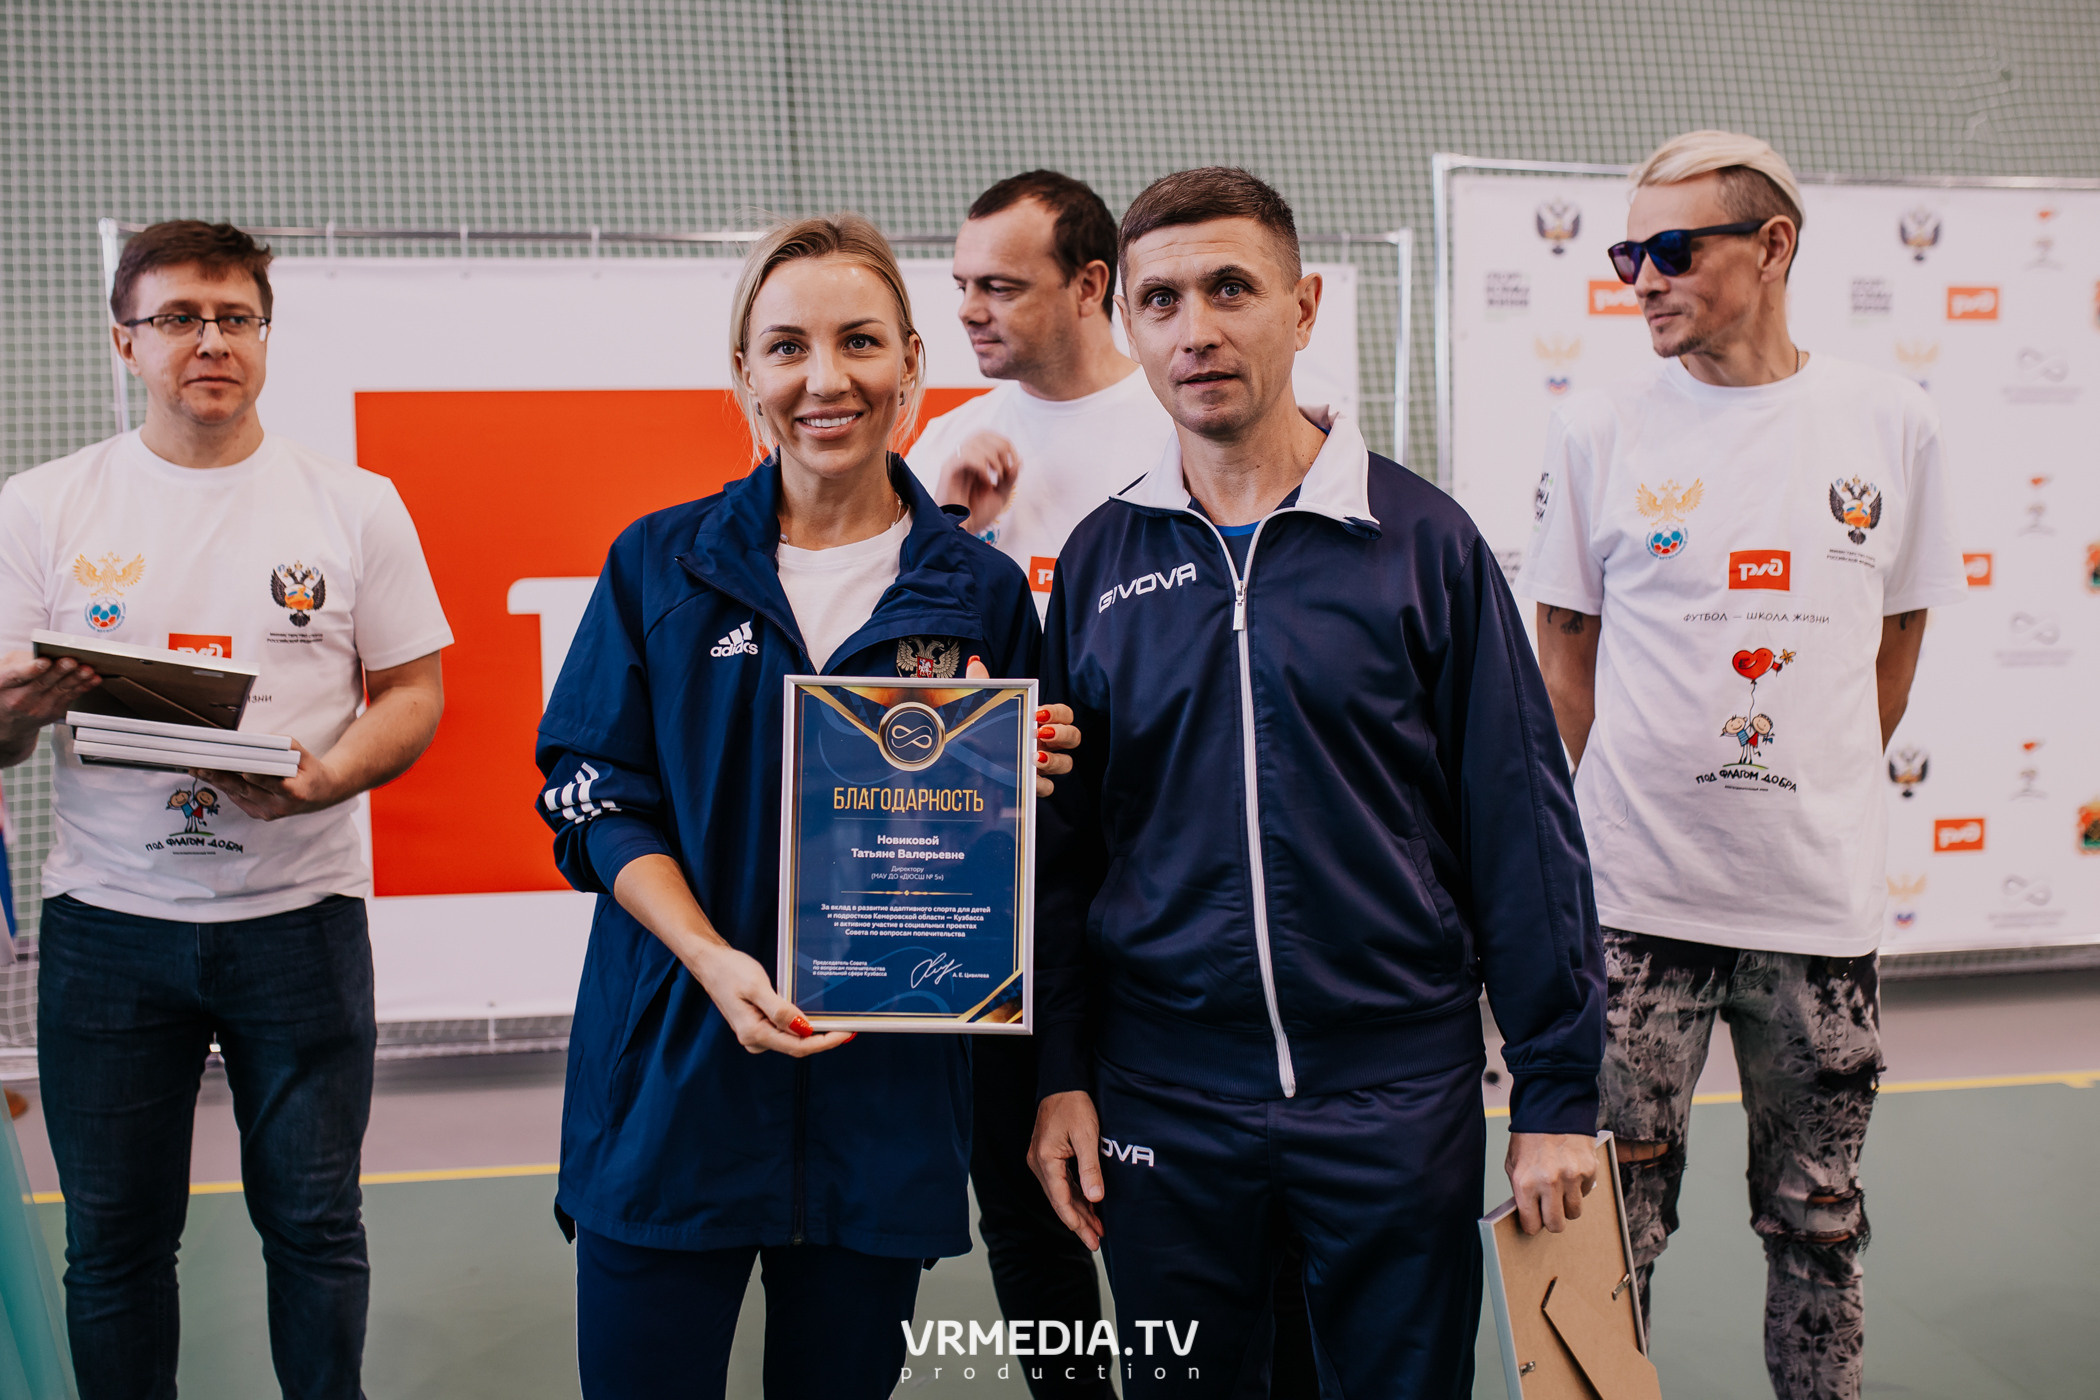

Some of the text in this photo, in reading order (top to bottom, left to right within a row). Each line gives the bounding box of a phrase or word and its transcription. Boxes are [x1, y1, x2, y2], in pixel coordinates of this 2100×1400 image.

[1098, 562, 1197, 613] GIVOVA
[1683, 612, 1728, 622] ФУТБОЛ
[1746, 611, 1789, 622] ШКОЛА
[1793, 613, 1830, 624] ЖИЗНИ
[1695, 772, 1717, 784] ПОД
[1719, 768, 1759, 781] ФЛАГОМ
[1761, 773, 1797, 793] ДОБРА
[833, 787, 984, 813] БЛАГОДАРНОСТЬ
[145, 840, 164, 851] ПОД
[877, 834, 940, 846] Новиковой
[851, 847, 965, 861] Татьяне Валерьевне
[890, 865, 924, 873] Директору
[821, 903, 830, 911] За
[831, 904, 851, 912] вклад
[889, 905, 932, 913] адаптивного
[957, 906, 970, 914] для
[971, 906, 991, 914] детей
[918, 913, 945, 921] области
[904, 922, 944, 930] социальных
[913, 930, 966, 938] попечительства
